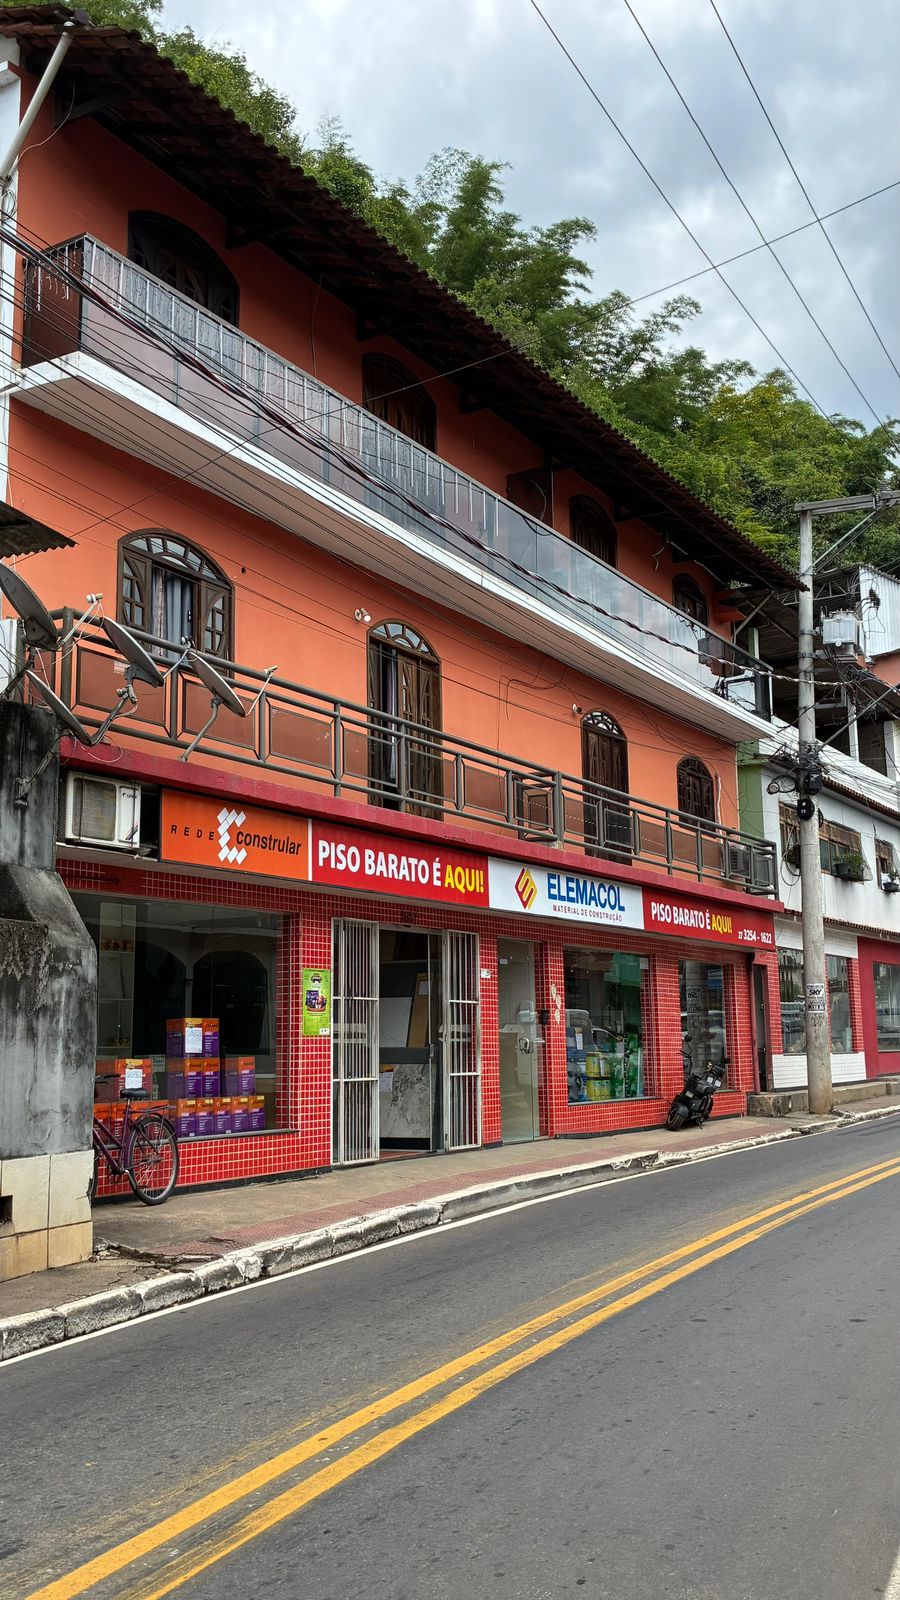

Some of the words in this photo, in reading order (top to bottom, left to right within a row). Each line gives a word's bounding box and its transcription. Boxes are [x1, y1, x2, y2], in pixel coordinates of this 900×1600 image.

[170, 824, 215, 841] REDE
[236, 830, 302, 855] constrular
[318, 839, 361, 873] PISO
[364, 848, 430, 885] BARATO
[432, 857, 442, 887] É
[444, 864, 484, 894] AQUI!
[547, 872, 625, 912] ELEMACOL
[552, 904, 580, 916] MATERIAL
[580, 908, 588, 917] DE
[588, 910, 623, 922] CONSTRUÇÃO
[650, 901, 672, 923] PISO
[672, 906, 705, 929] BARATO
[706, 909, 711, 930] É
[712, 914, 733, 934] AQUI!
[743, 928, 757, 942] 3254
[760, 931, 773, 944] 1622
